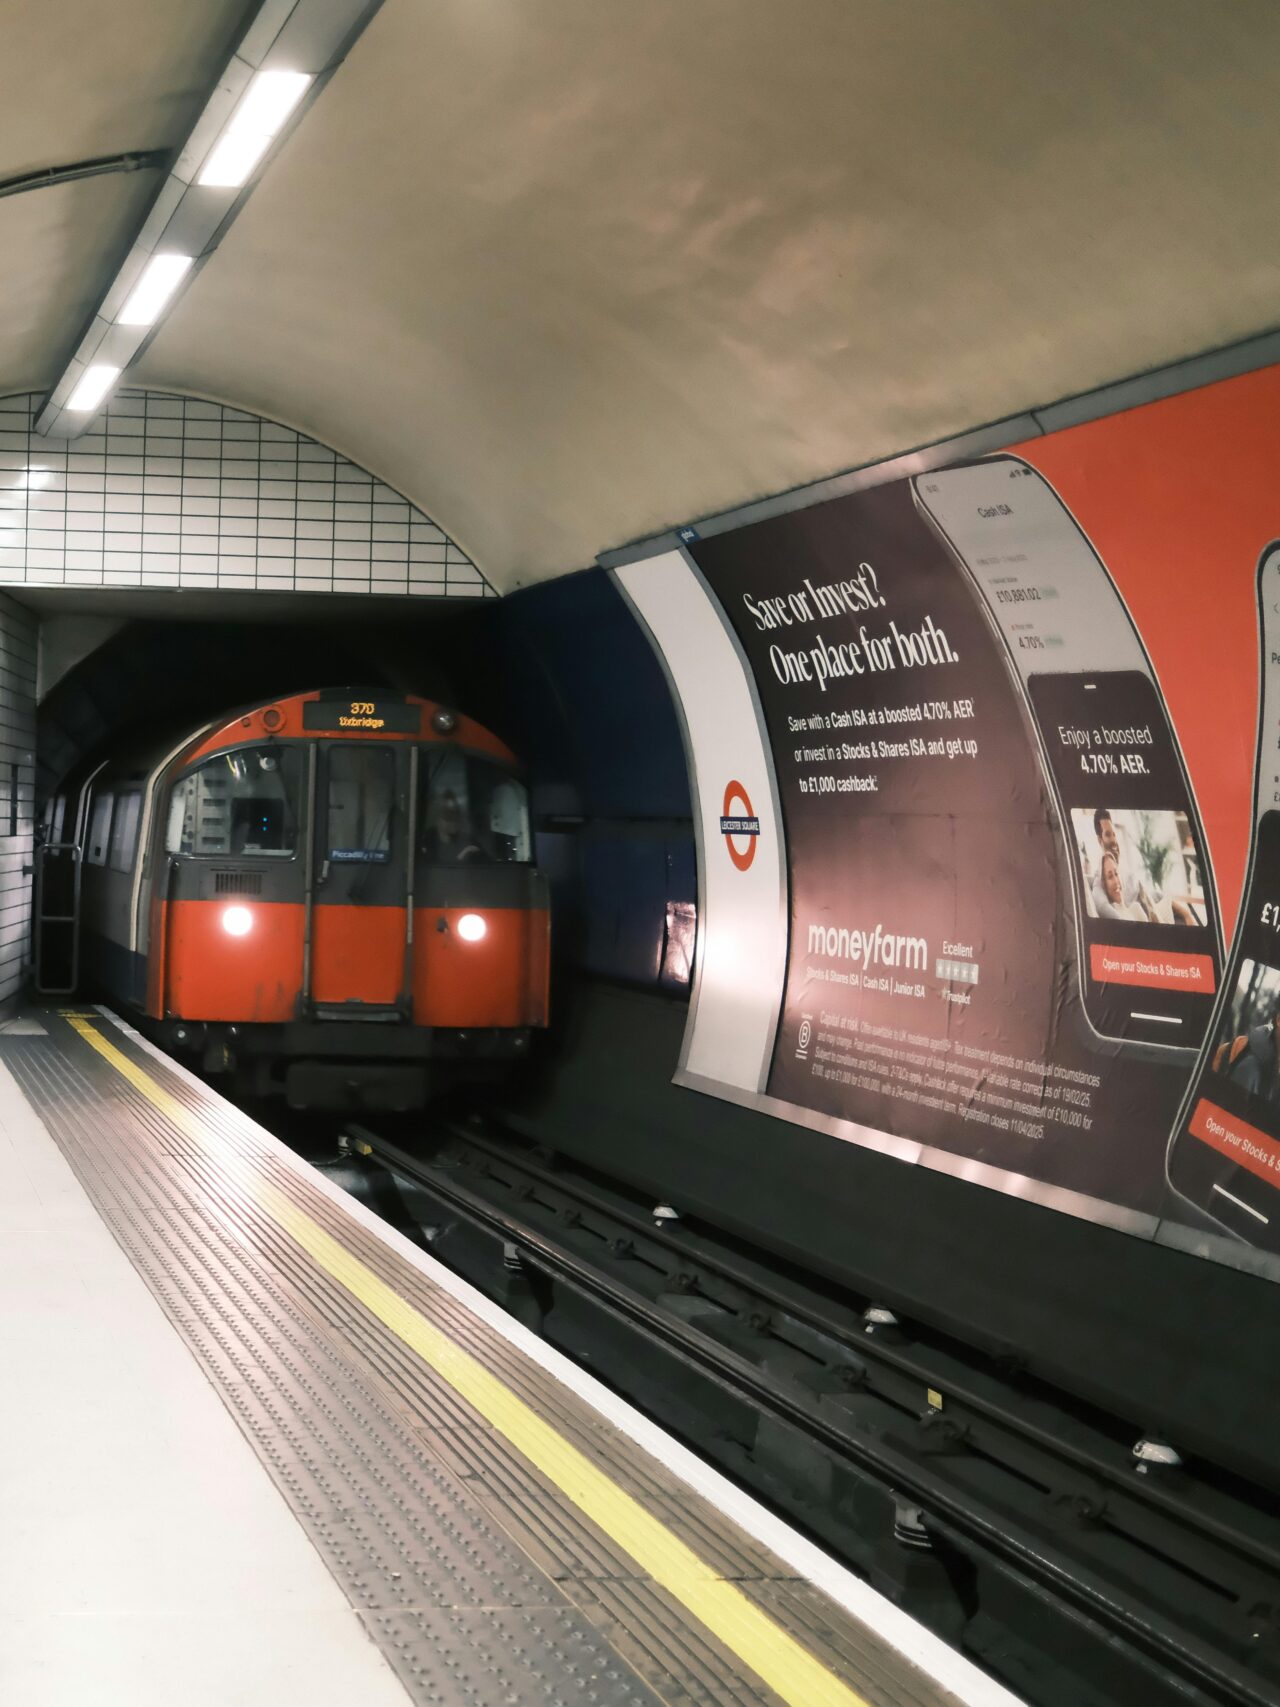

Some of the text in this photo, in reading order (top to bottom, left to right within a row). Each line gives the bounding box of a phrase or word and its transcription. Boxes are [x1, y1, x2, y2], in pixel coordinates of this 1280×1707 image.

[743, 562, 886, 630] Save or Invest?
[769, 615, 959, 691] One place for both.
[350, 702, 375, 715] 370
[788, 716, 807, 731] Save
[807, 713, 824, 730] with
[825, 716, 831, 728] a
[831, 711, 852, 728] Cash
[852, 709, 867, 726] ISA
[868, 711, 878, 725] at
[878, 711, 885, 723] a
[884, 704, 922, 723] boosted
[923, 701, 952, 720] 4.70%
[339, 716, 384, 728] Uxbridge
[1058, 725, 1153, 749] Enjoy a boosted
[794, 737, 977, 762] or invest in a Stocks & Shares ISA and get up
[1081, 754, 1150, 774] 4.70% AER.
[799, 778, 807, 792] to
[808, 776, 836, 795] £1,000
[808, 924, 927, 970] moneyfarm
[942, 940, 973, 958] Excellent
[830, 969, 849, 984] Shares
[849, 971, 859, 986] ISA
[1102, 958, 1202, 979] Open your Stocks & Shares ISA
[863, 975, 889, 992] Cash ISA
[893, 981, 926, 998] Junior ISA
[945, 989, 971, 1005] Trustpilot
[1015, 1058, 1023, 1070] on
[1053, 1064, 1100, 1087] circumstances
[1009, 1078, 1021, 1091] rate
[1053, 1086, 1062, 1099] of
[990, 1113, 1009, 1130] closes
[1013, 1098, 1047, 1118] investment
[1047, 1106, 1056, 1119] of
[1055, 1107, 1082, 1127] £10,000
[1083, 1114, 1093, 1130] for
[1205, 1117, 1225, 1137] Open
[1223, 1130, 1242, 1146] your
[1241, 1138, 1268, 1163] Stocks
[1268, 1154, 1276, 1167] &
